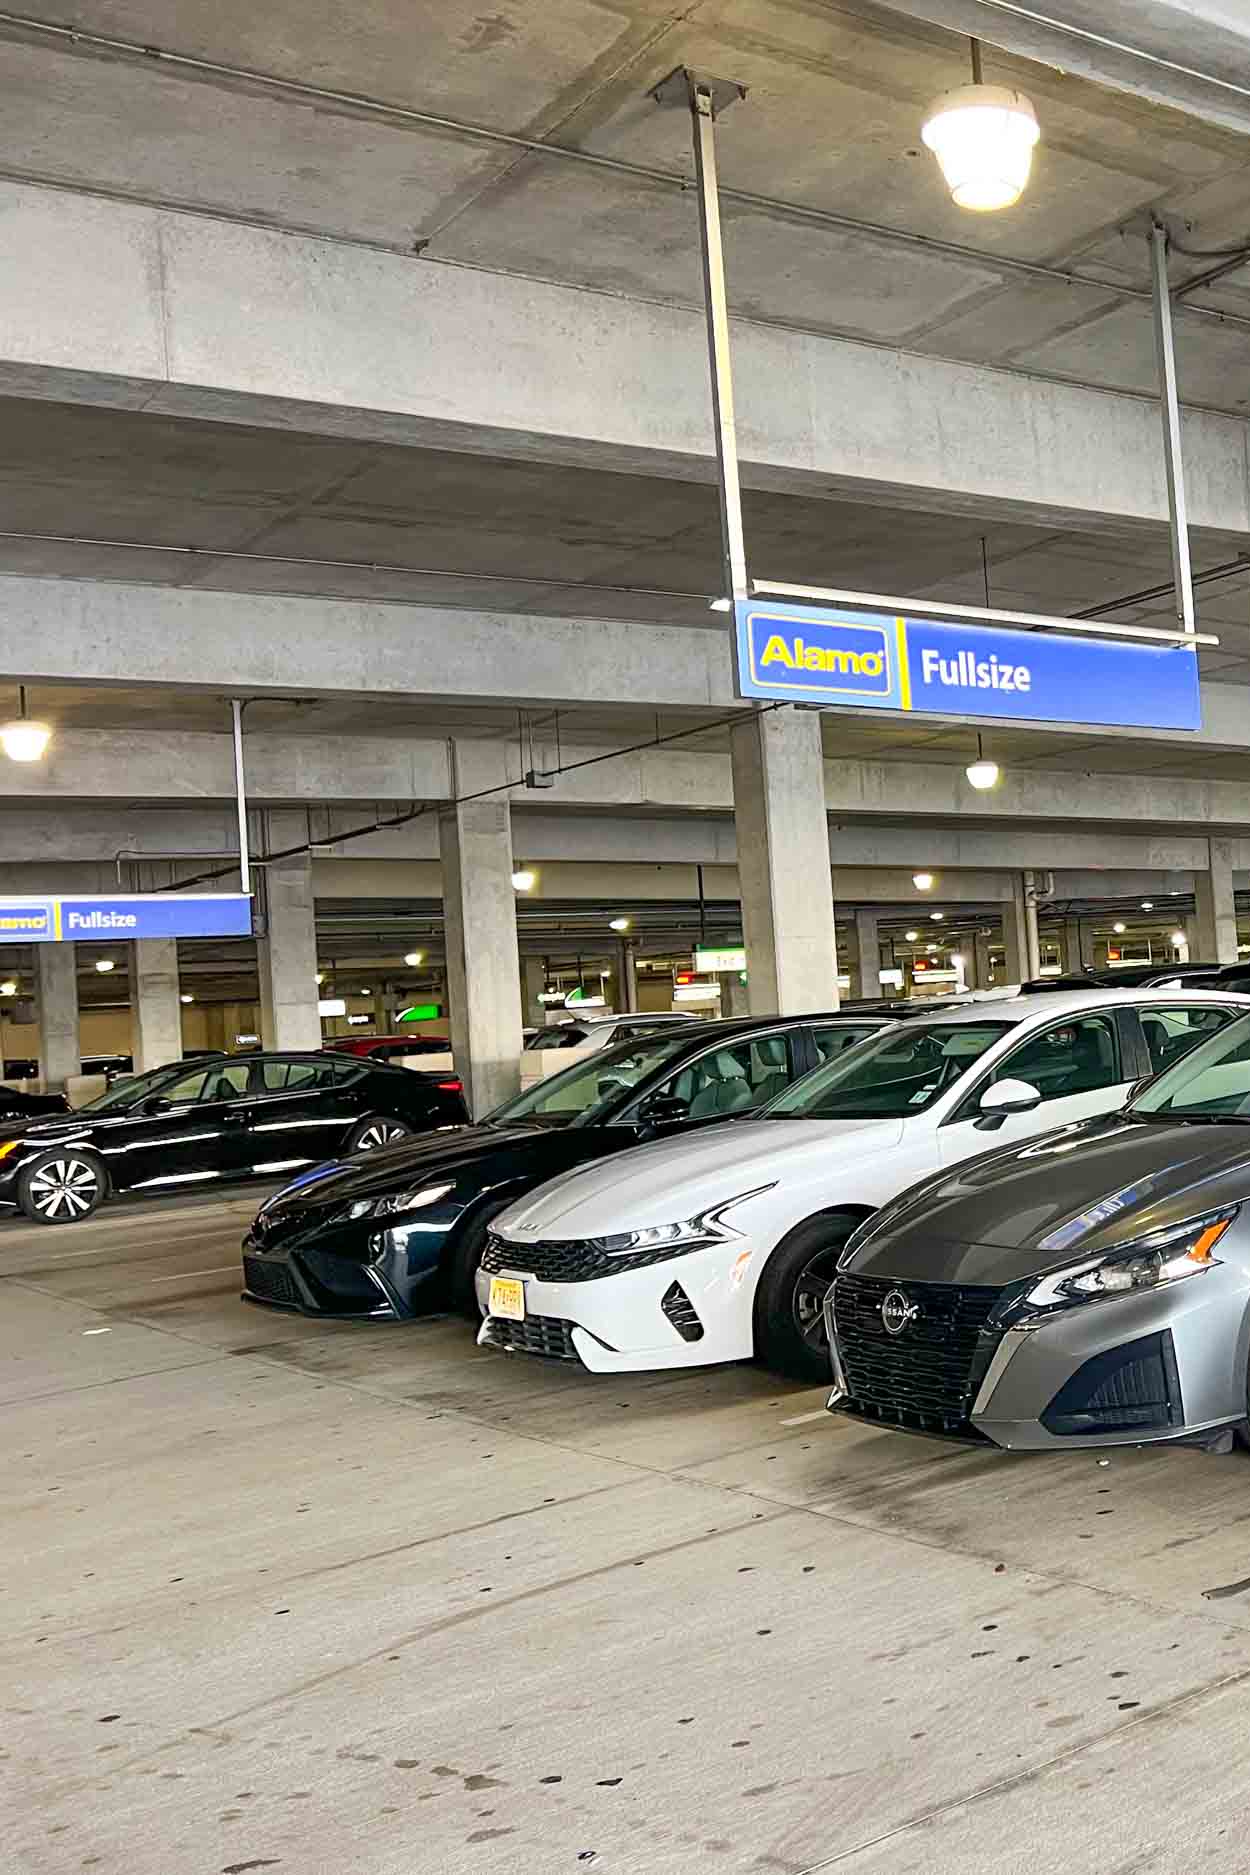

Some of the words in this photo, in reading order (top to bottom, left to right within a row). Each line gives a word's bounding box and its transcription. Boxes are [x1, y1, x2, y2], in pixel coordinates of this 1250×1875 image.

[760, 634, 884, 676] Alamo
[921, 648, 1031, 692] Fullsize
[0, 915, 47, 929] amo
[68, 911, 137, 929] Fullsize
[881, 1306, 912, 1318] SSAN
